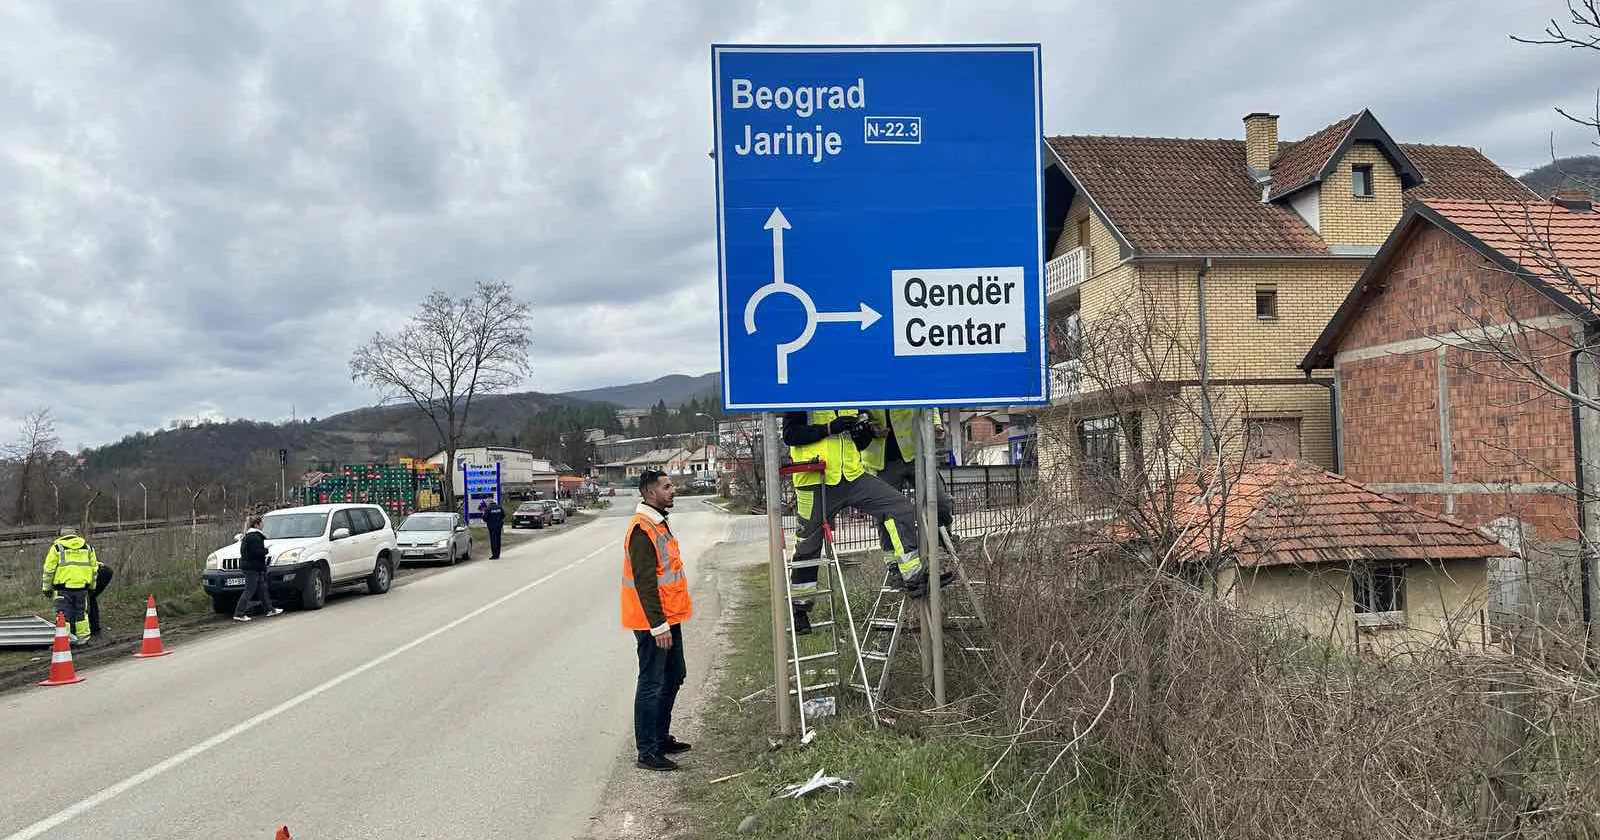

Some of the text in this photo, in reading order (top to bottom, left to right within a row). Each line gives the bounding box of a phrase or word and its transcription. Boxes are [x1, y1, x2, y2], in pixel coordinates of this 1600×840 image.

[732, 78, 866, 117] Beograd
[735, 125, 842, 163] Jarinje
[866, 121, 919, 138] N-22.3
[904, 276, 1015, 309] Qendër
[905, 317, 1006, 347] Centar
